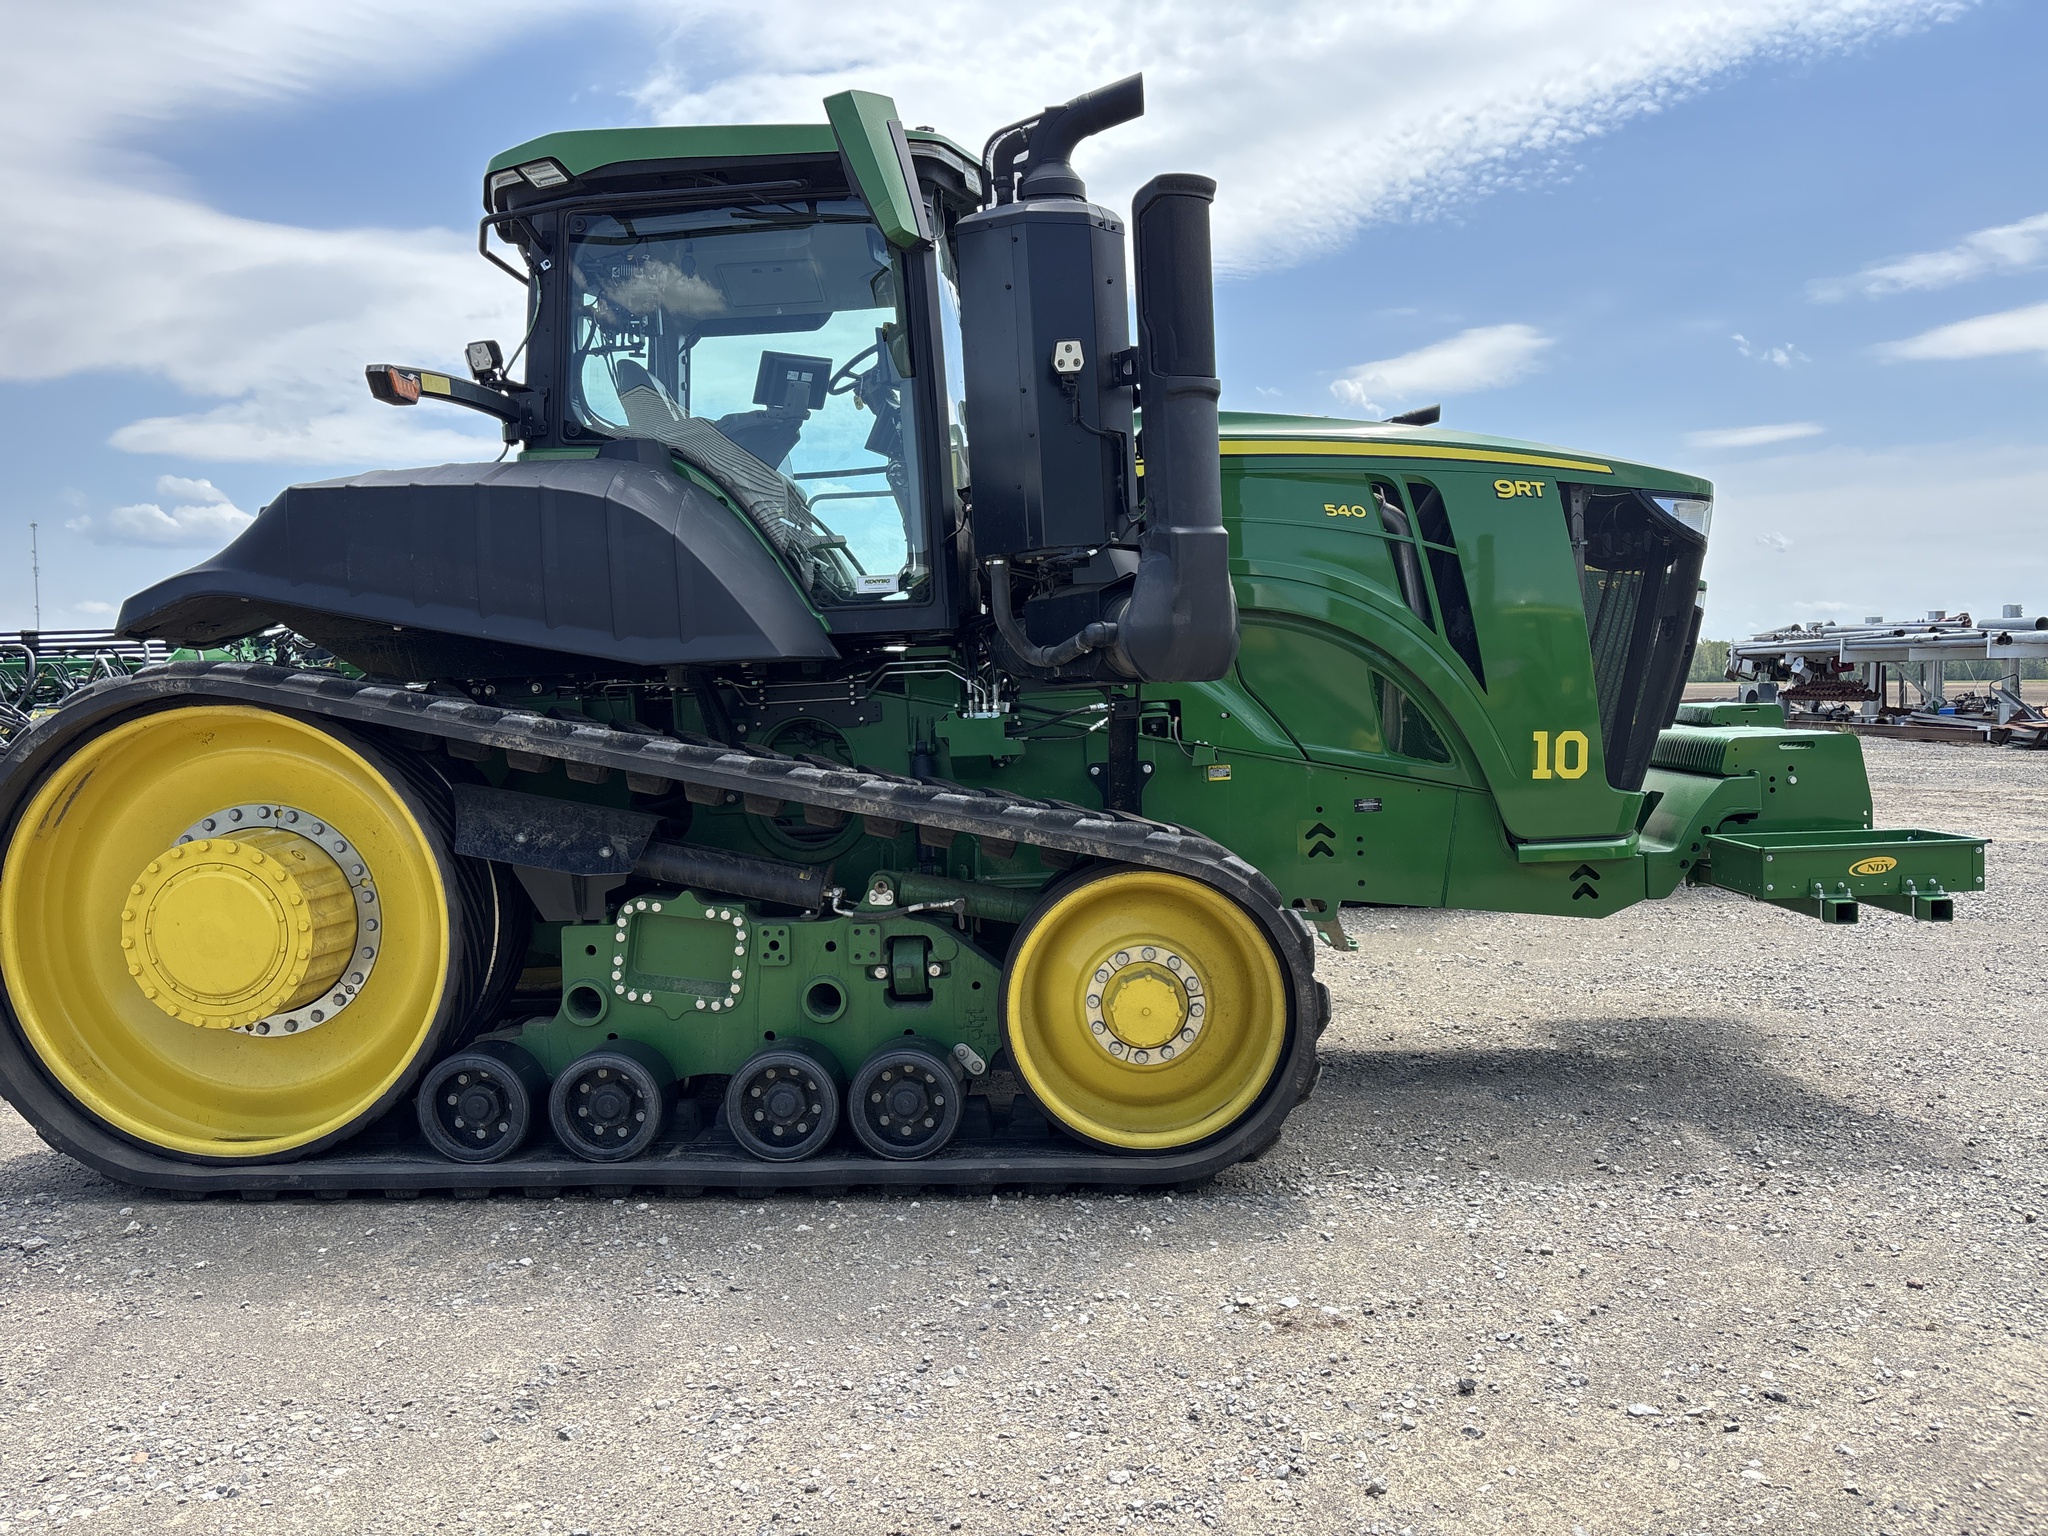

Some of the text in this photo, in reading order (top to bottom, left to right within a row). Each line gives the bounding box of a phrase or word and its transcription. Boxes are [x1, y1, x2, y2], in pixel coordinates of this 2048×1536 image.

[1493, 479, 1546, 499] 9RT
[1323, 503, 1367, 518] 540
[1532, 730, 1589, 779] 10
[1866, 863, 1893, 873] NDY
